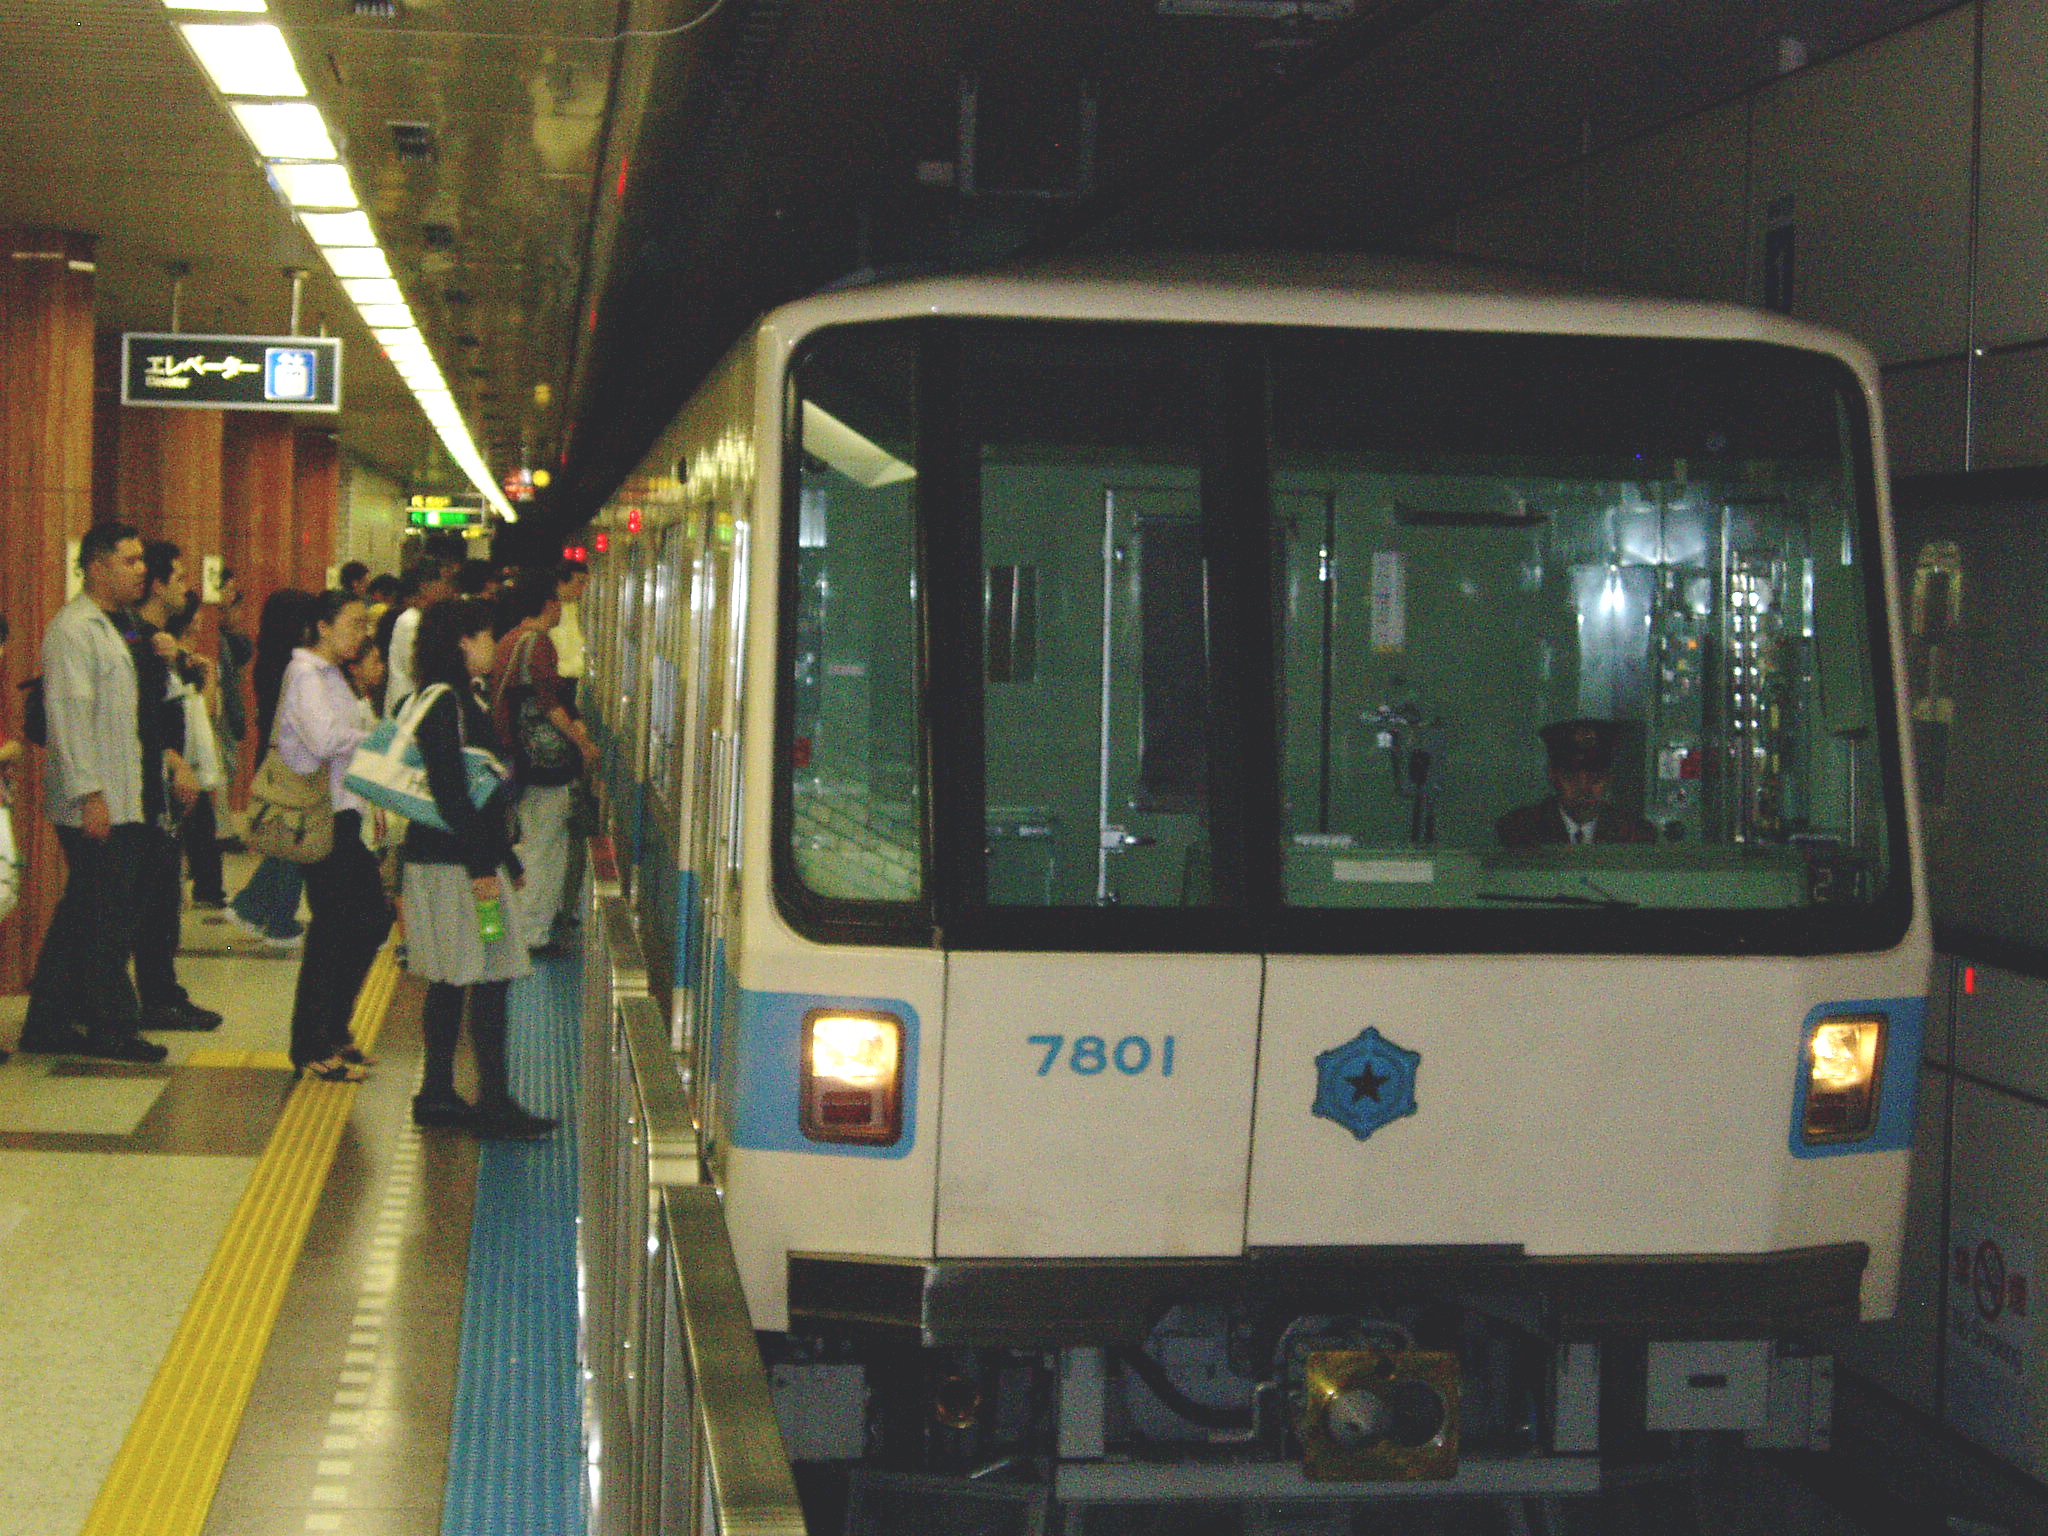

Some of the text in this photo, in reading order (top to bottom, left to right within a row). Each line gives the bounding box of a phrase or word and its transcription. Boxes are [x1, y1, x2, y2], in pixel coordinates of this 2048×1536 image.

[144, 355, 262, 380] エレベーター
[1027, 1034, 1175, 1077] 7801
